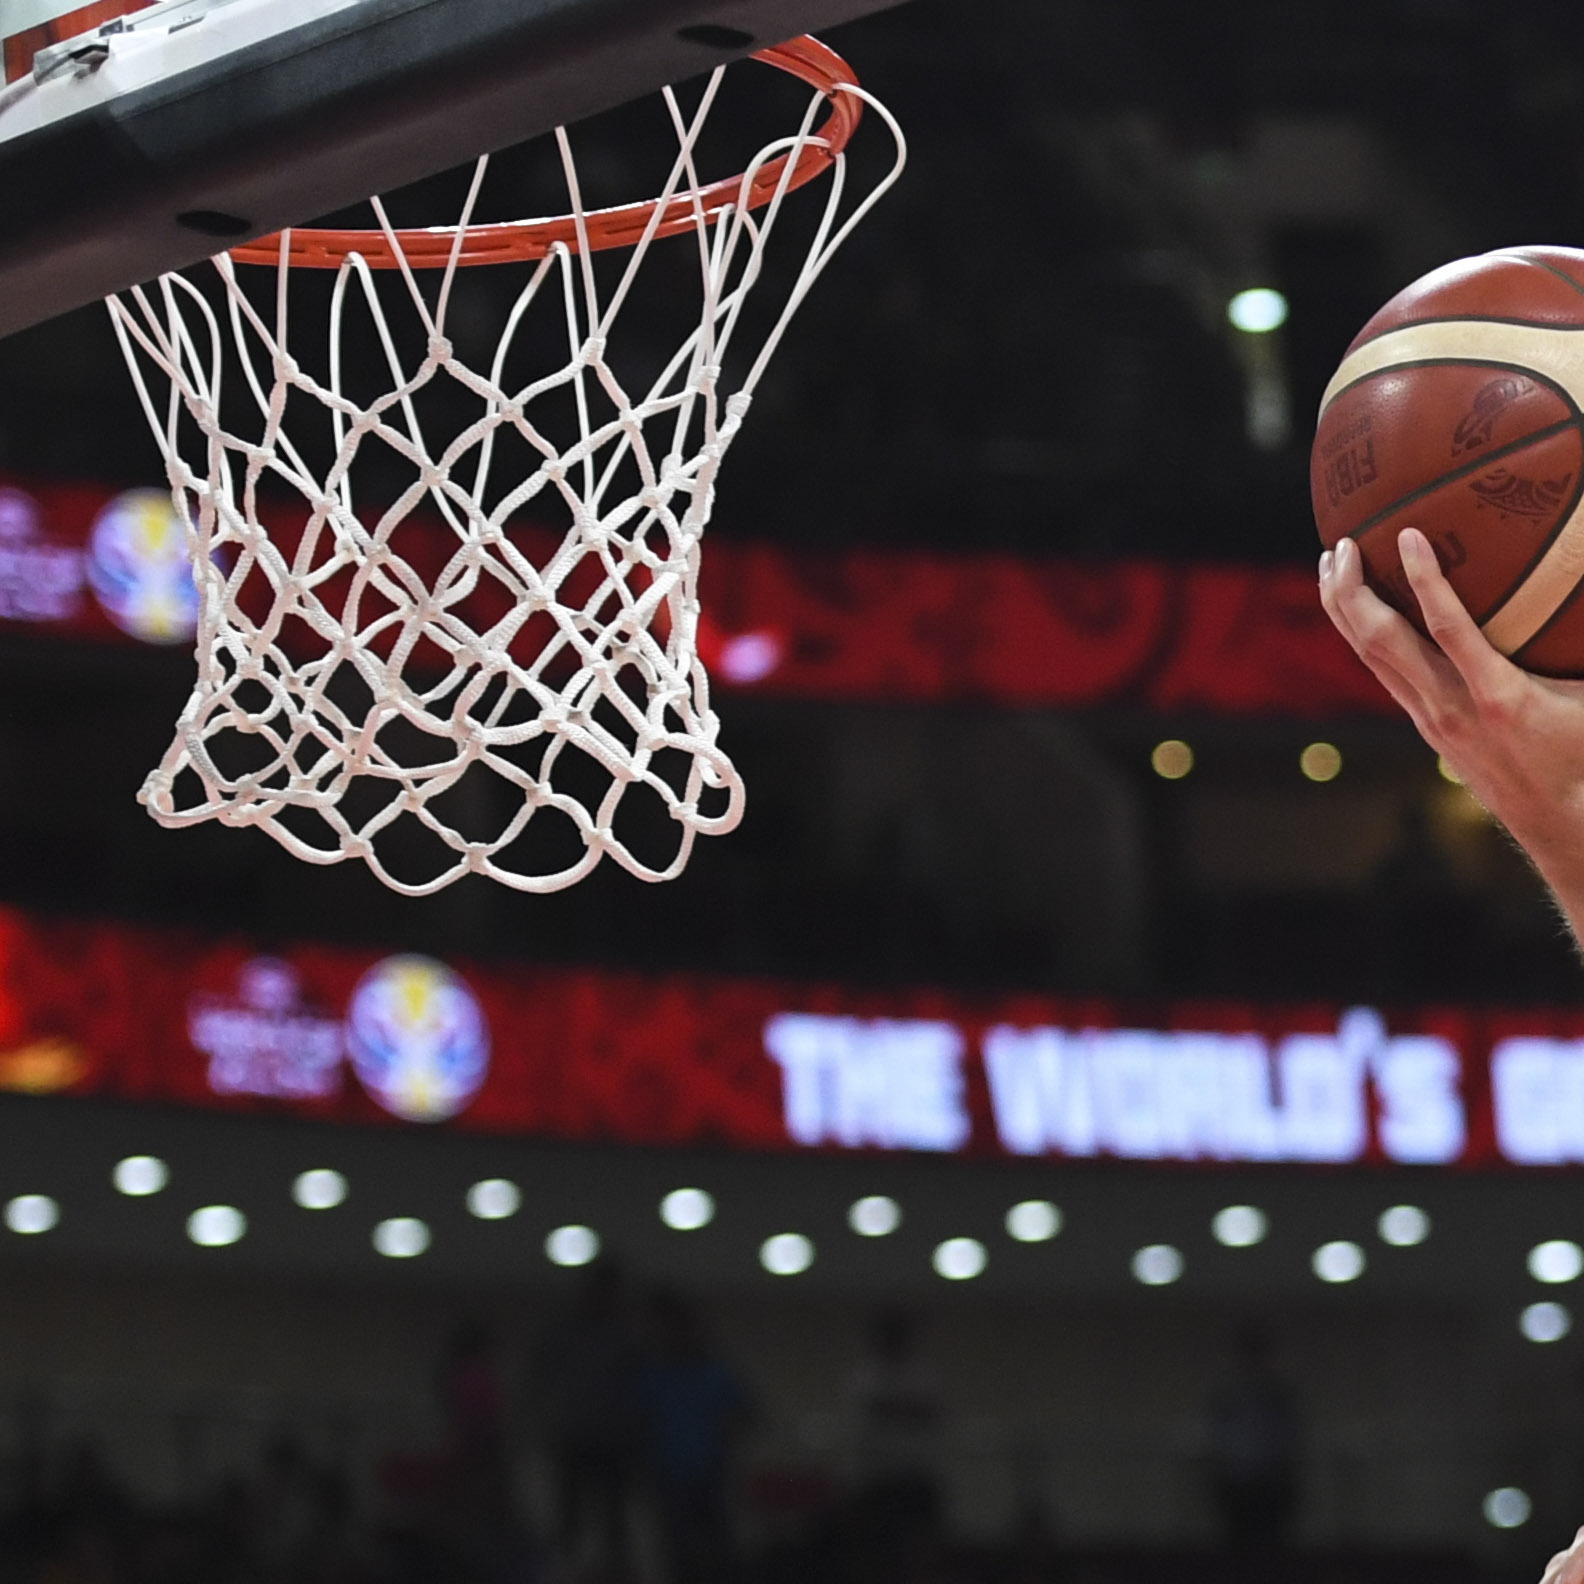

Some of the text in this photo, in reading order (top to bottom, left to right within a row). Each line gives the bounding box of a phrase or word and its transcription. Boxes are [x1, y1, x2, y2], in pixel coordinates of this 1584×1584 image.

[1324, 436, 1378, 507] FIBA
[763, 1012, 972, 1152] THE
[982, 1004, 1466, 1164] WORLD'S
